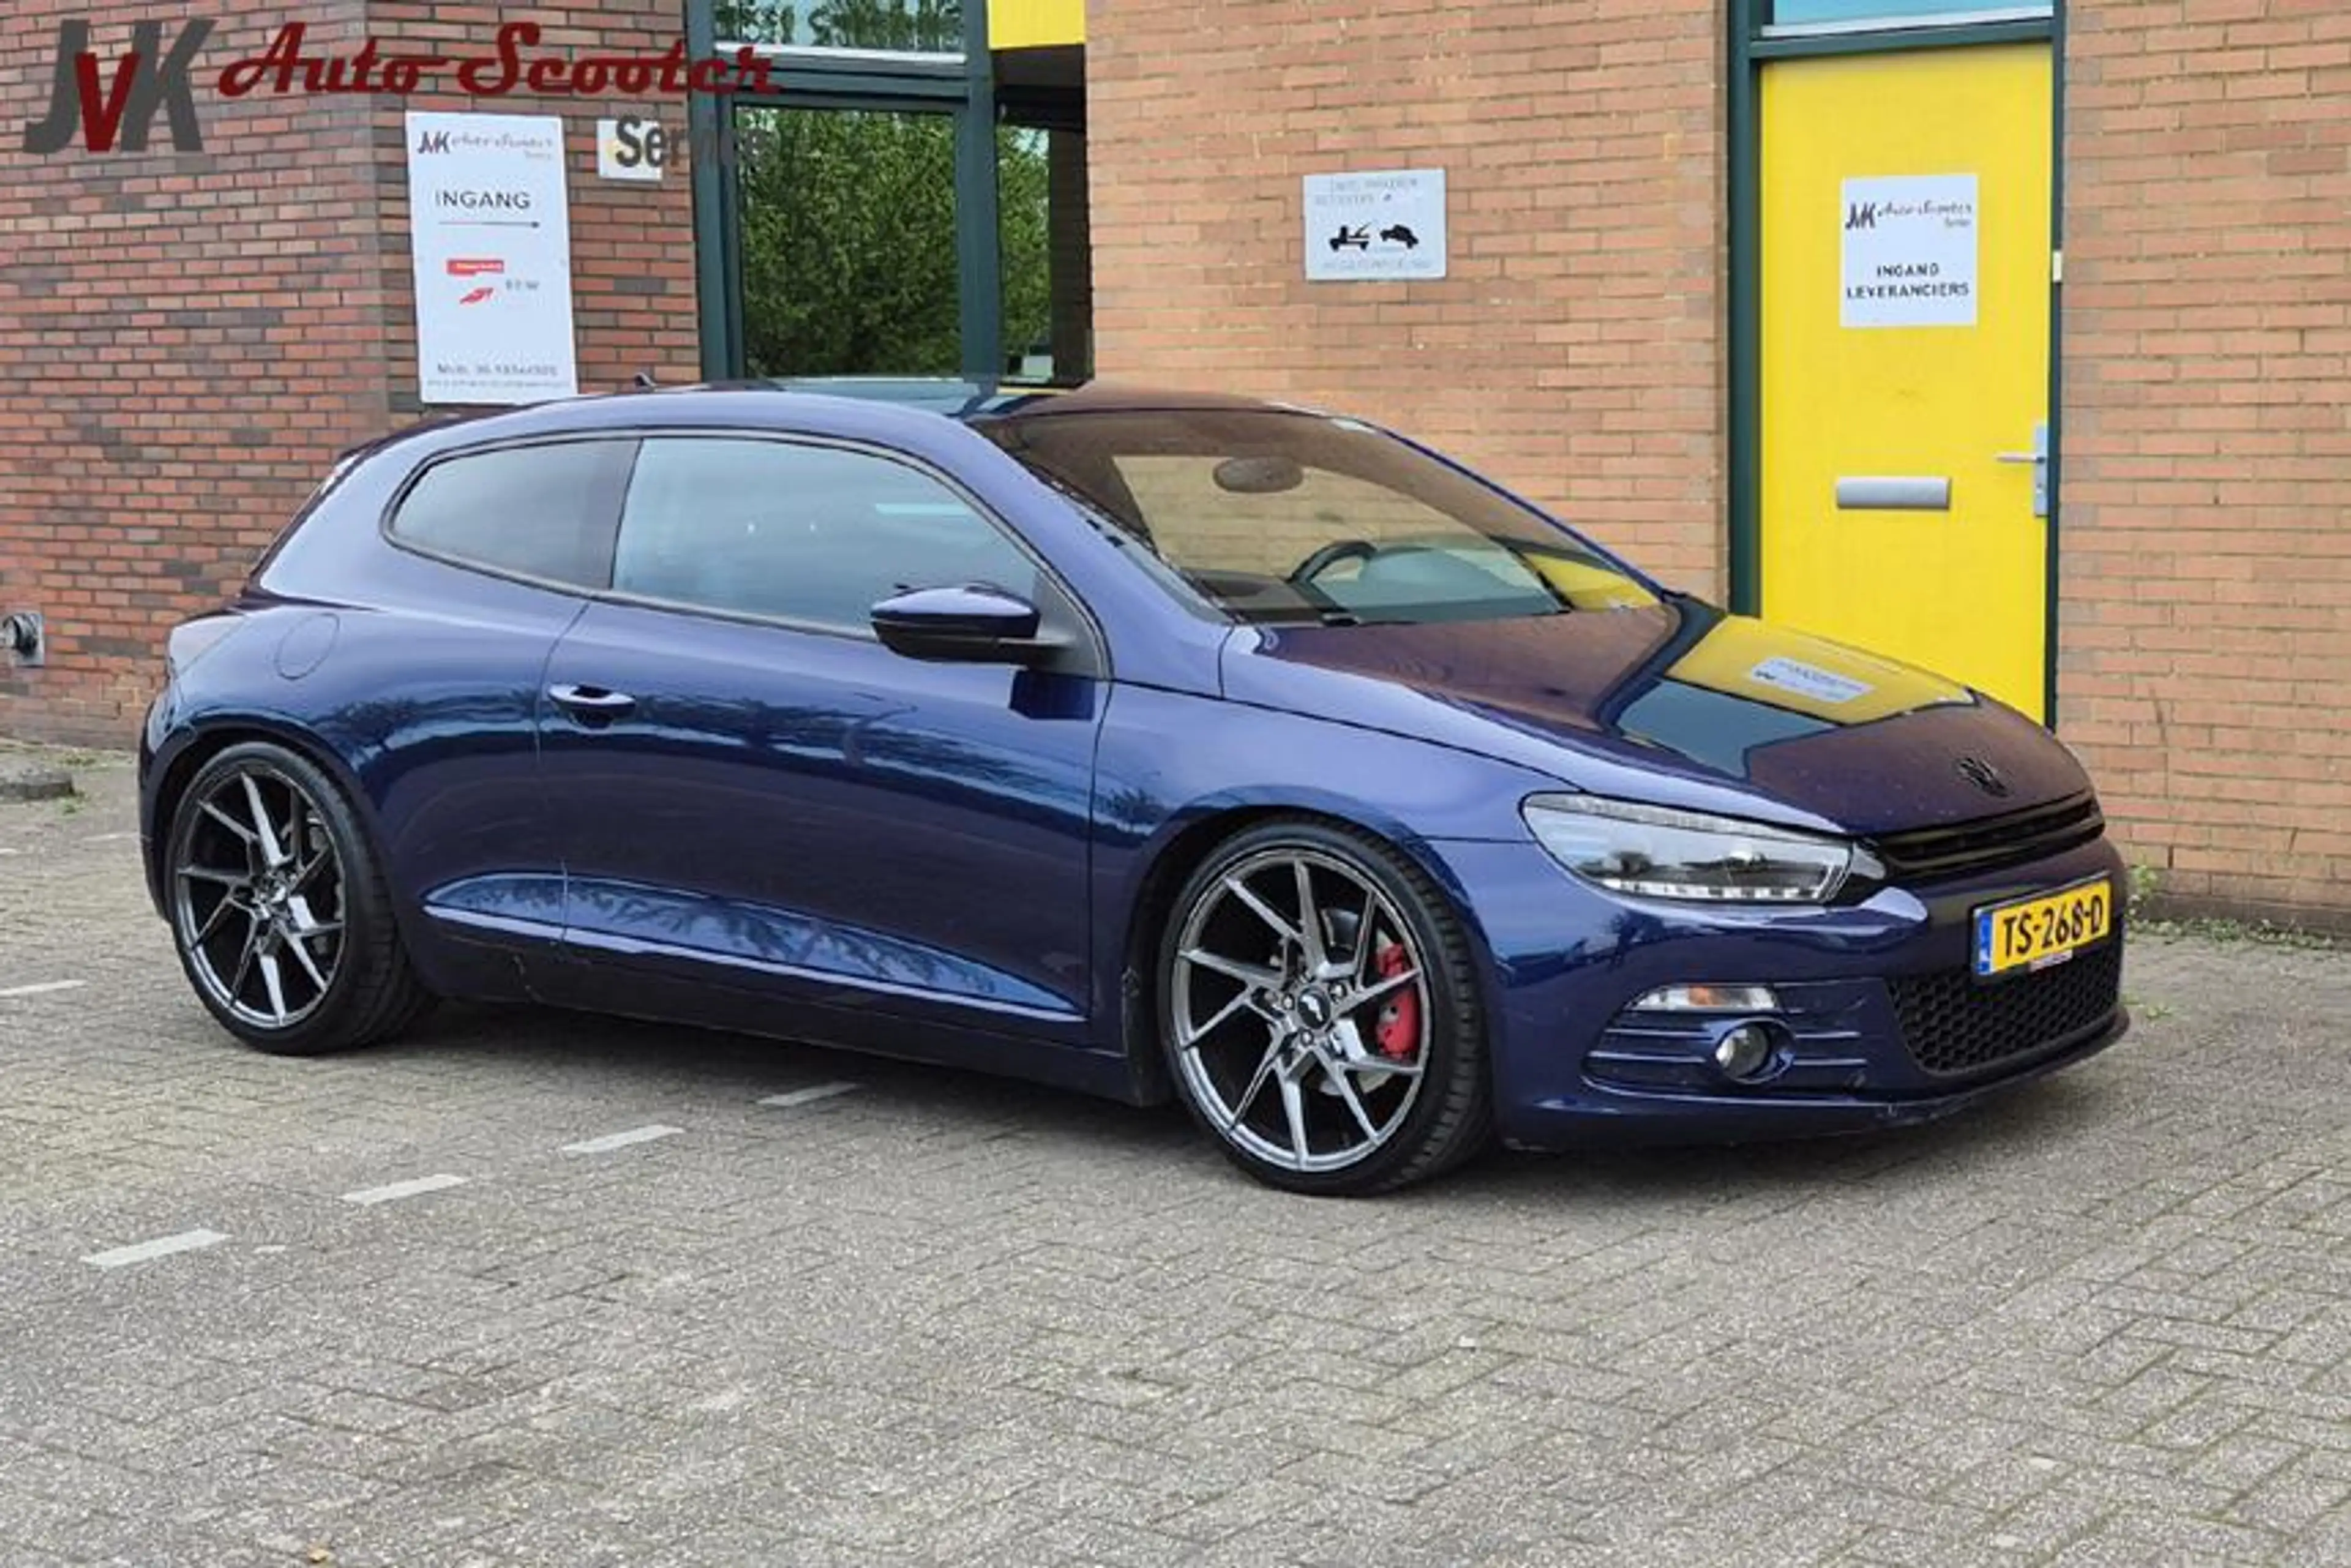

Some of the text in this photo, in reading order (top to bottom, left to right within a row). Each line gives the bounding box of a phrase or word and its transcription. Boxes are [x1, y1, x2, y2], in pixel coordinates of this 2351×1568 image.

[434, 189, 531, 209] INGANG
[1847, 282, 1970, 299] LEVERANCIERS
[2003, 894, 2103, 959] TS-268-D
